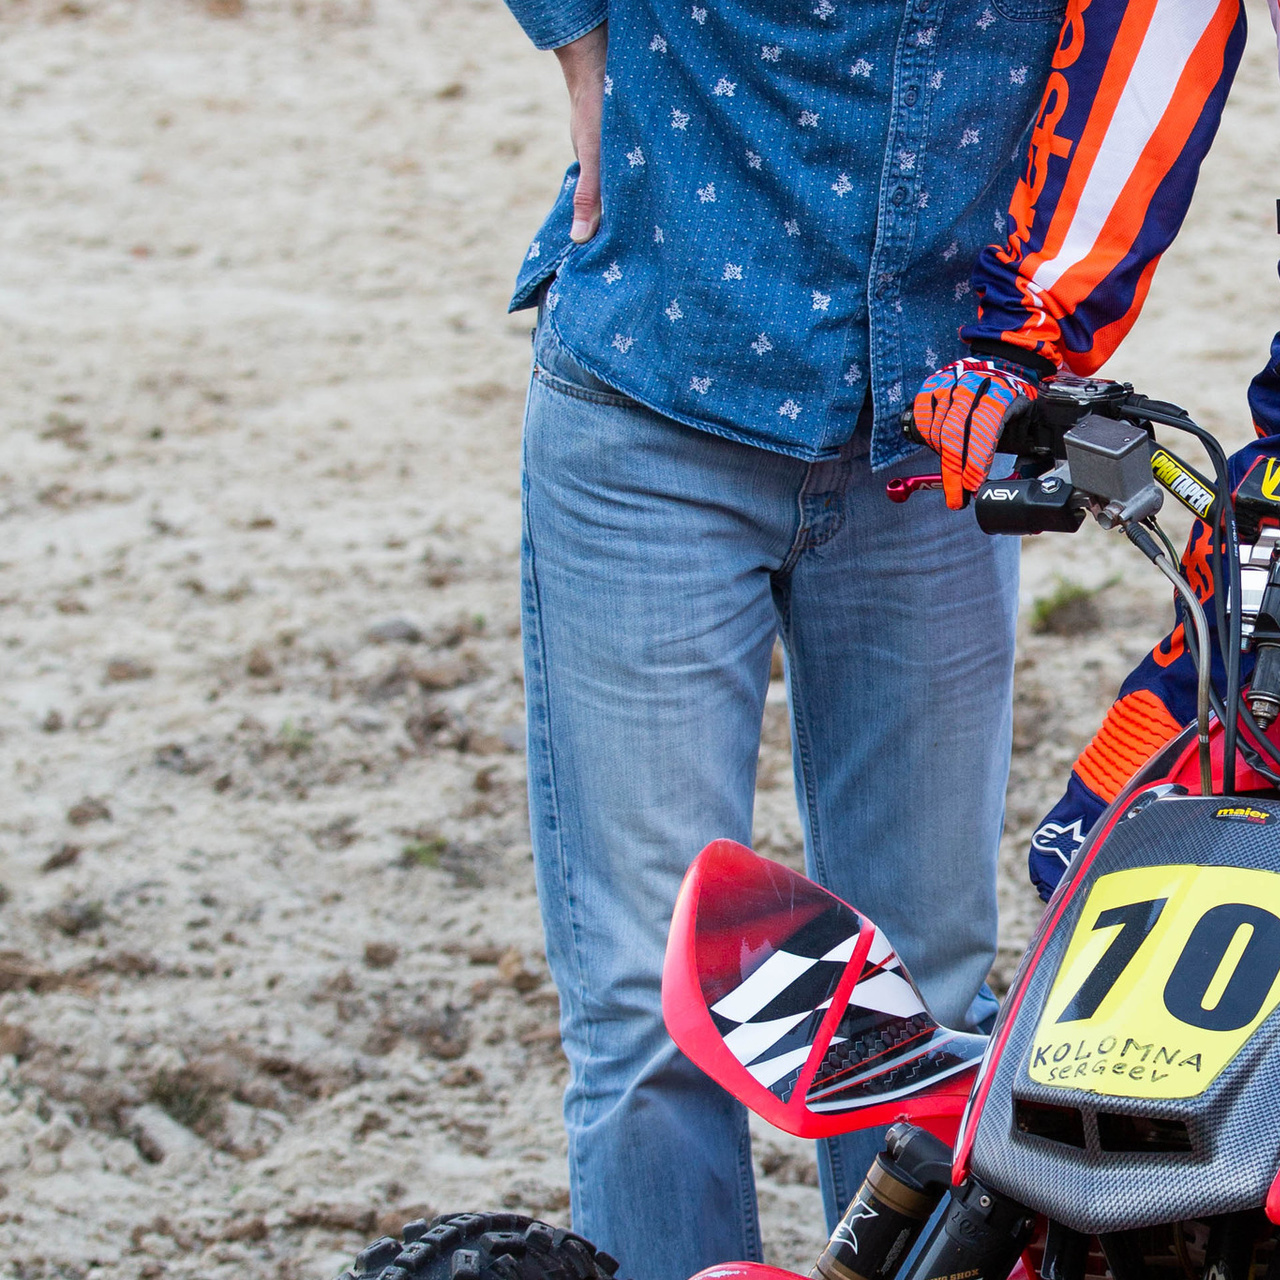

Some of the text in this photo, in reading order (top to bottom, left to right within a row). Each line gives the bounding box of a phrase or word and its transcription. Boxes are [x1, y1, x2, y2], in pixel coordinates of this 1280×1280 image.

[918, 482, 943, 490] AS
[1151, 455, 1213, 513] PROTAPER
[981, 488, 1020, 501] ASV
[1217, 807, 1270, 819] maier
[1033, 1034, 1203, 1073] KOLOMNA
